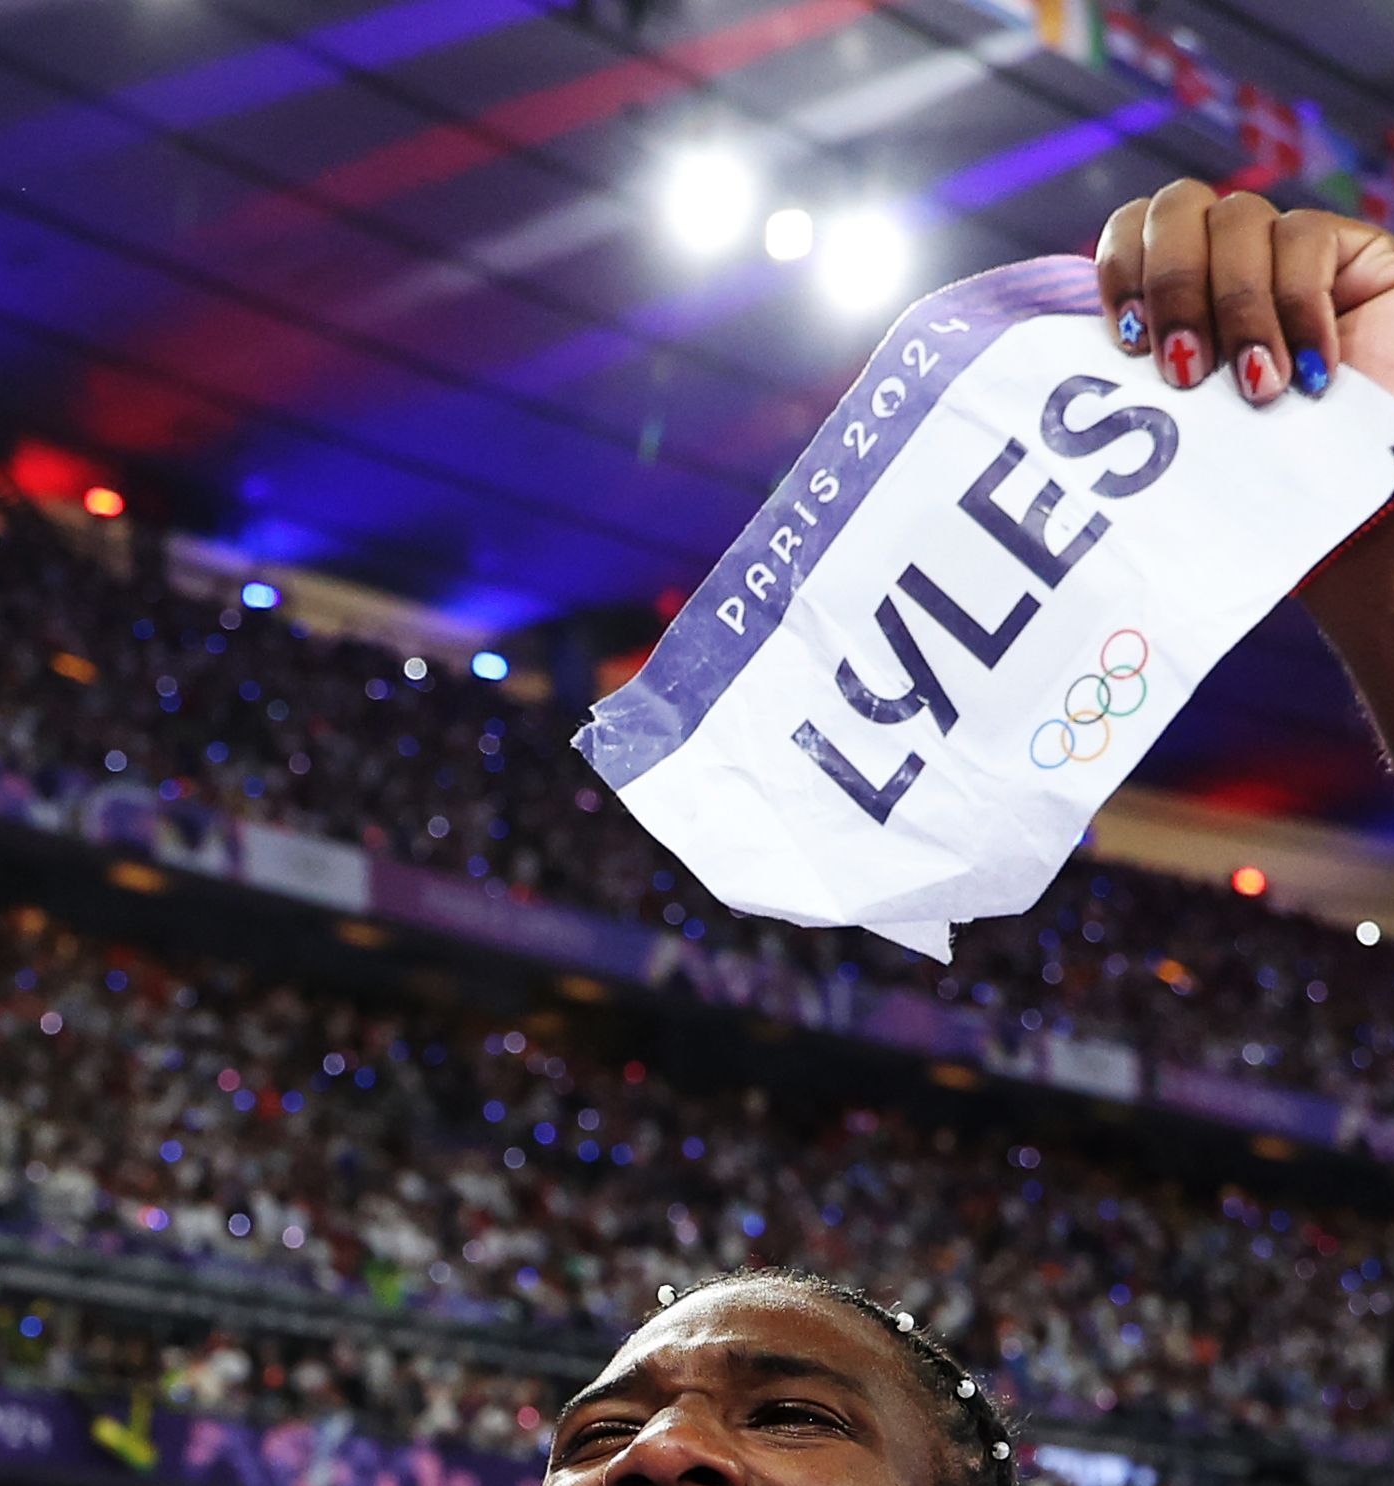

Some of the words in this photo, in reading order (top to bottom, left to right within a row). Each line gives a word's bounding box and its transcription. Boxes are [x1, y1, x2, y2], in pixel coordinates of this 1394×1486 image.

[715, 469, 840, 636] PARIS
[842, 317, 971, 460] 2024
[790, 374, 1180, 827] LYLES
